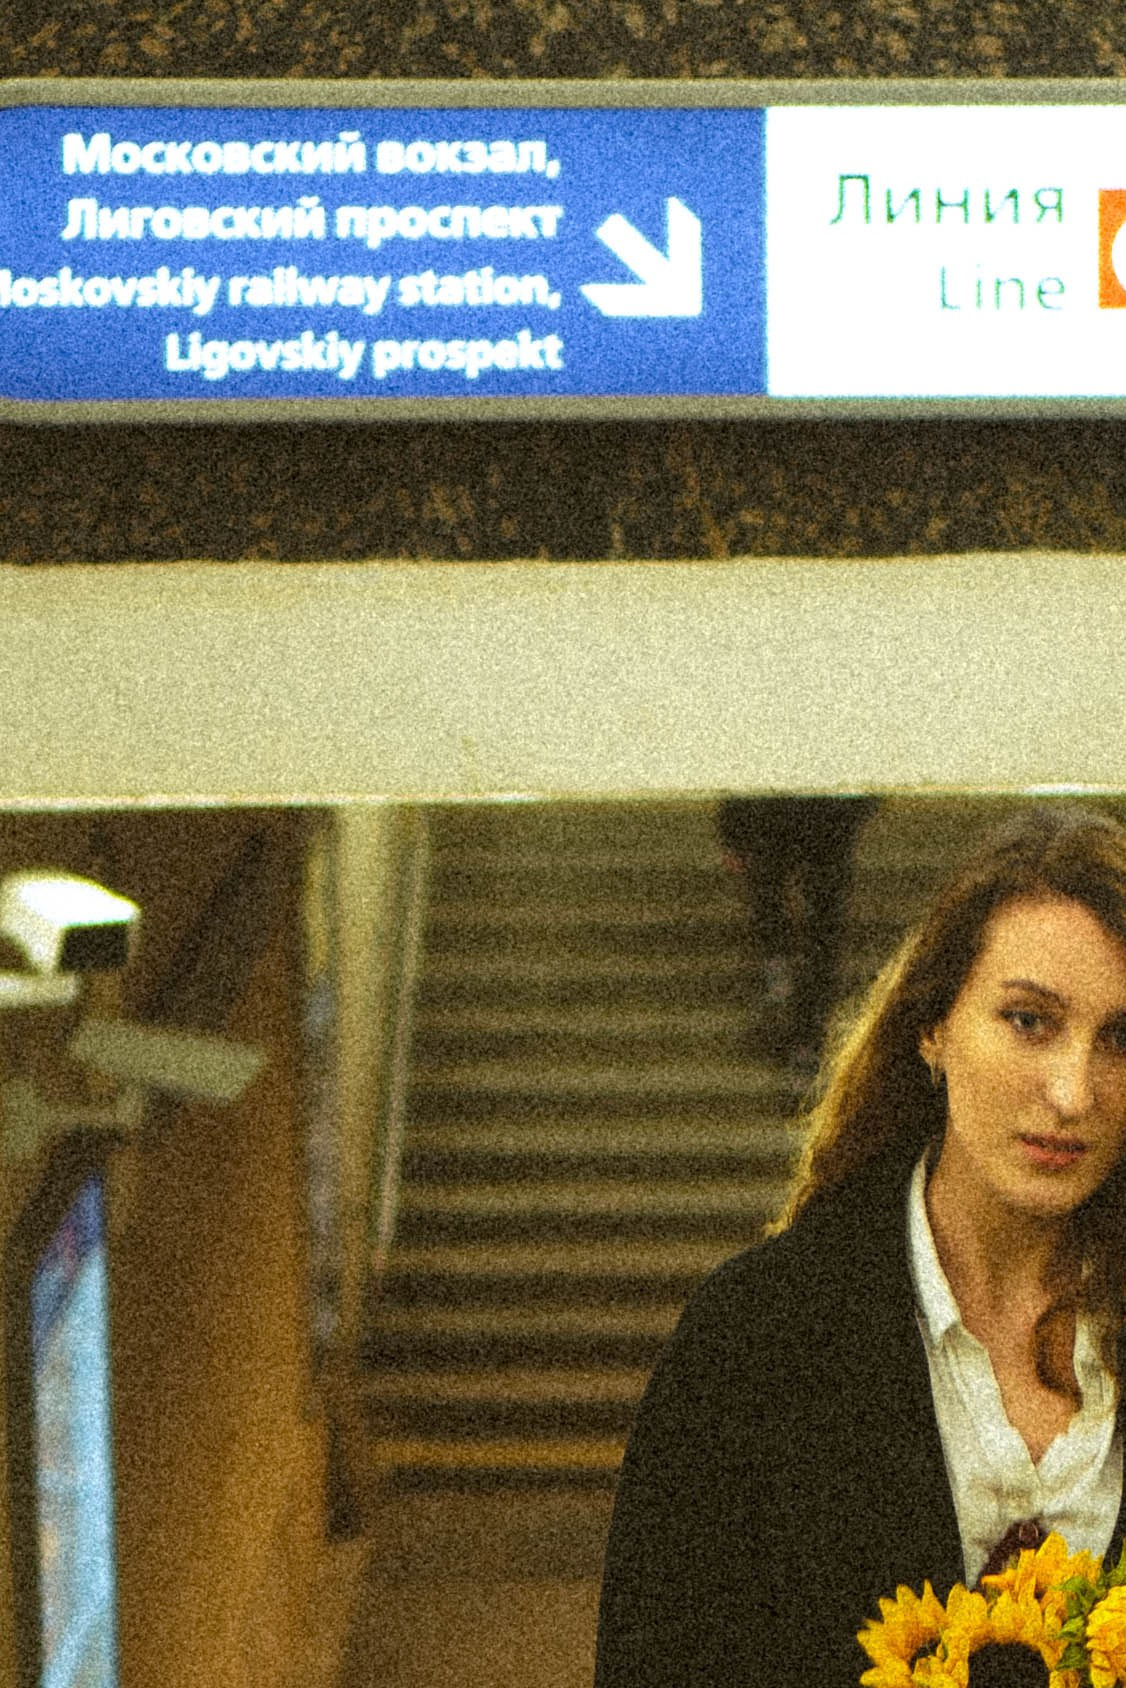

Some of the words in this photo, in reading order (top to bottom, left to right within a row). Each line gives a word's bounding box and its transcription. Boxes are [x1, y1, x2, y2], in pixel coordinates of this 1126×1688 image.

[64, 132, 366, 174] Московский
[377, 141, 560, 178] вокзал,
[63, 197, 325, 239] Лиговский
[336, 205, 563, 249] проспект
[829, 172, 1065, 225] Линия
[0, 267, 220, 315] oskovskiy
[229, 266, 391, 314] railway
[399, 267, 560, 309] station,
[939, 267, 1066, 310] Line
[167, 331, 364, 379] Ligovskiy
[373, 330, 562, 378] prospekt
